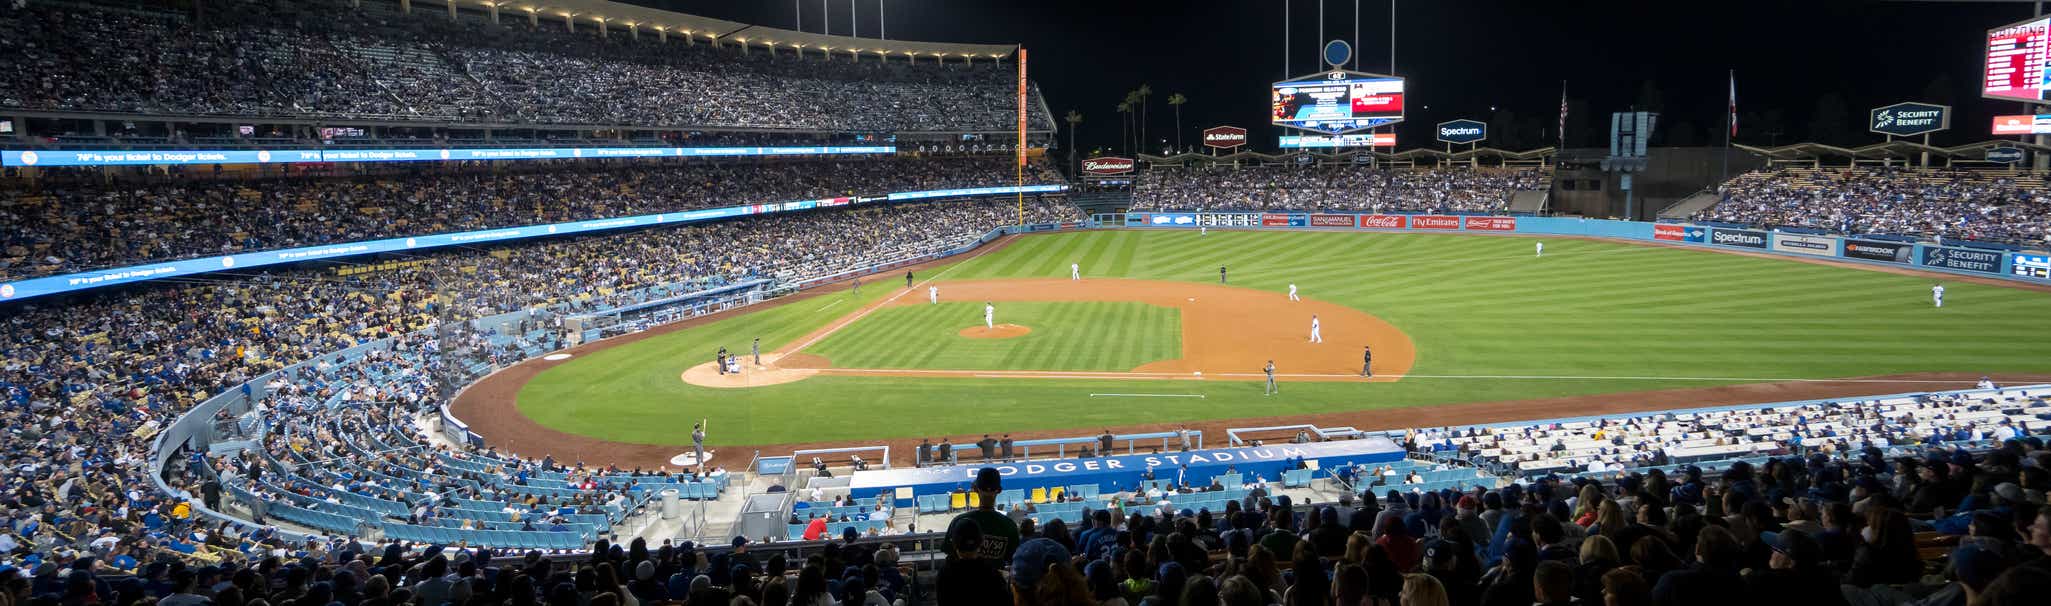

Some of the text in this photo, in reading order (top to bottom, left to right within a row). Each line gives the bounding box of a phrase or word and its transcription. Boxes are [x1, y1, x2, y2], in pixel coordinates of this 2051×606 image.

[1897, 110, 1939, 119] SECURITY
[1896, 118, 1933, 126] BENEFIT
[1441, 127, 1479, 136] Spectrum
[103, 154, 124, 163] your
[126, 153, 151, 161] ticket
[152, 153, 162, 161] to
[163, 153, 196, 163] Dodger
[1085, 161, 1132, 170] Budweiser
[1413, 217, 1425, 226] Fly
[1425, 217, 1459, 227] Emirates
[1714, 231, 1761, 245] Spectrum
[1948, 249, 1997, 262] SECURITY
[1947, 259, 1990, 271] BENEFIT
[966, 447, 1310, 478] DODGER STADIUM
